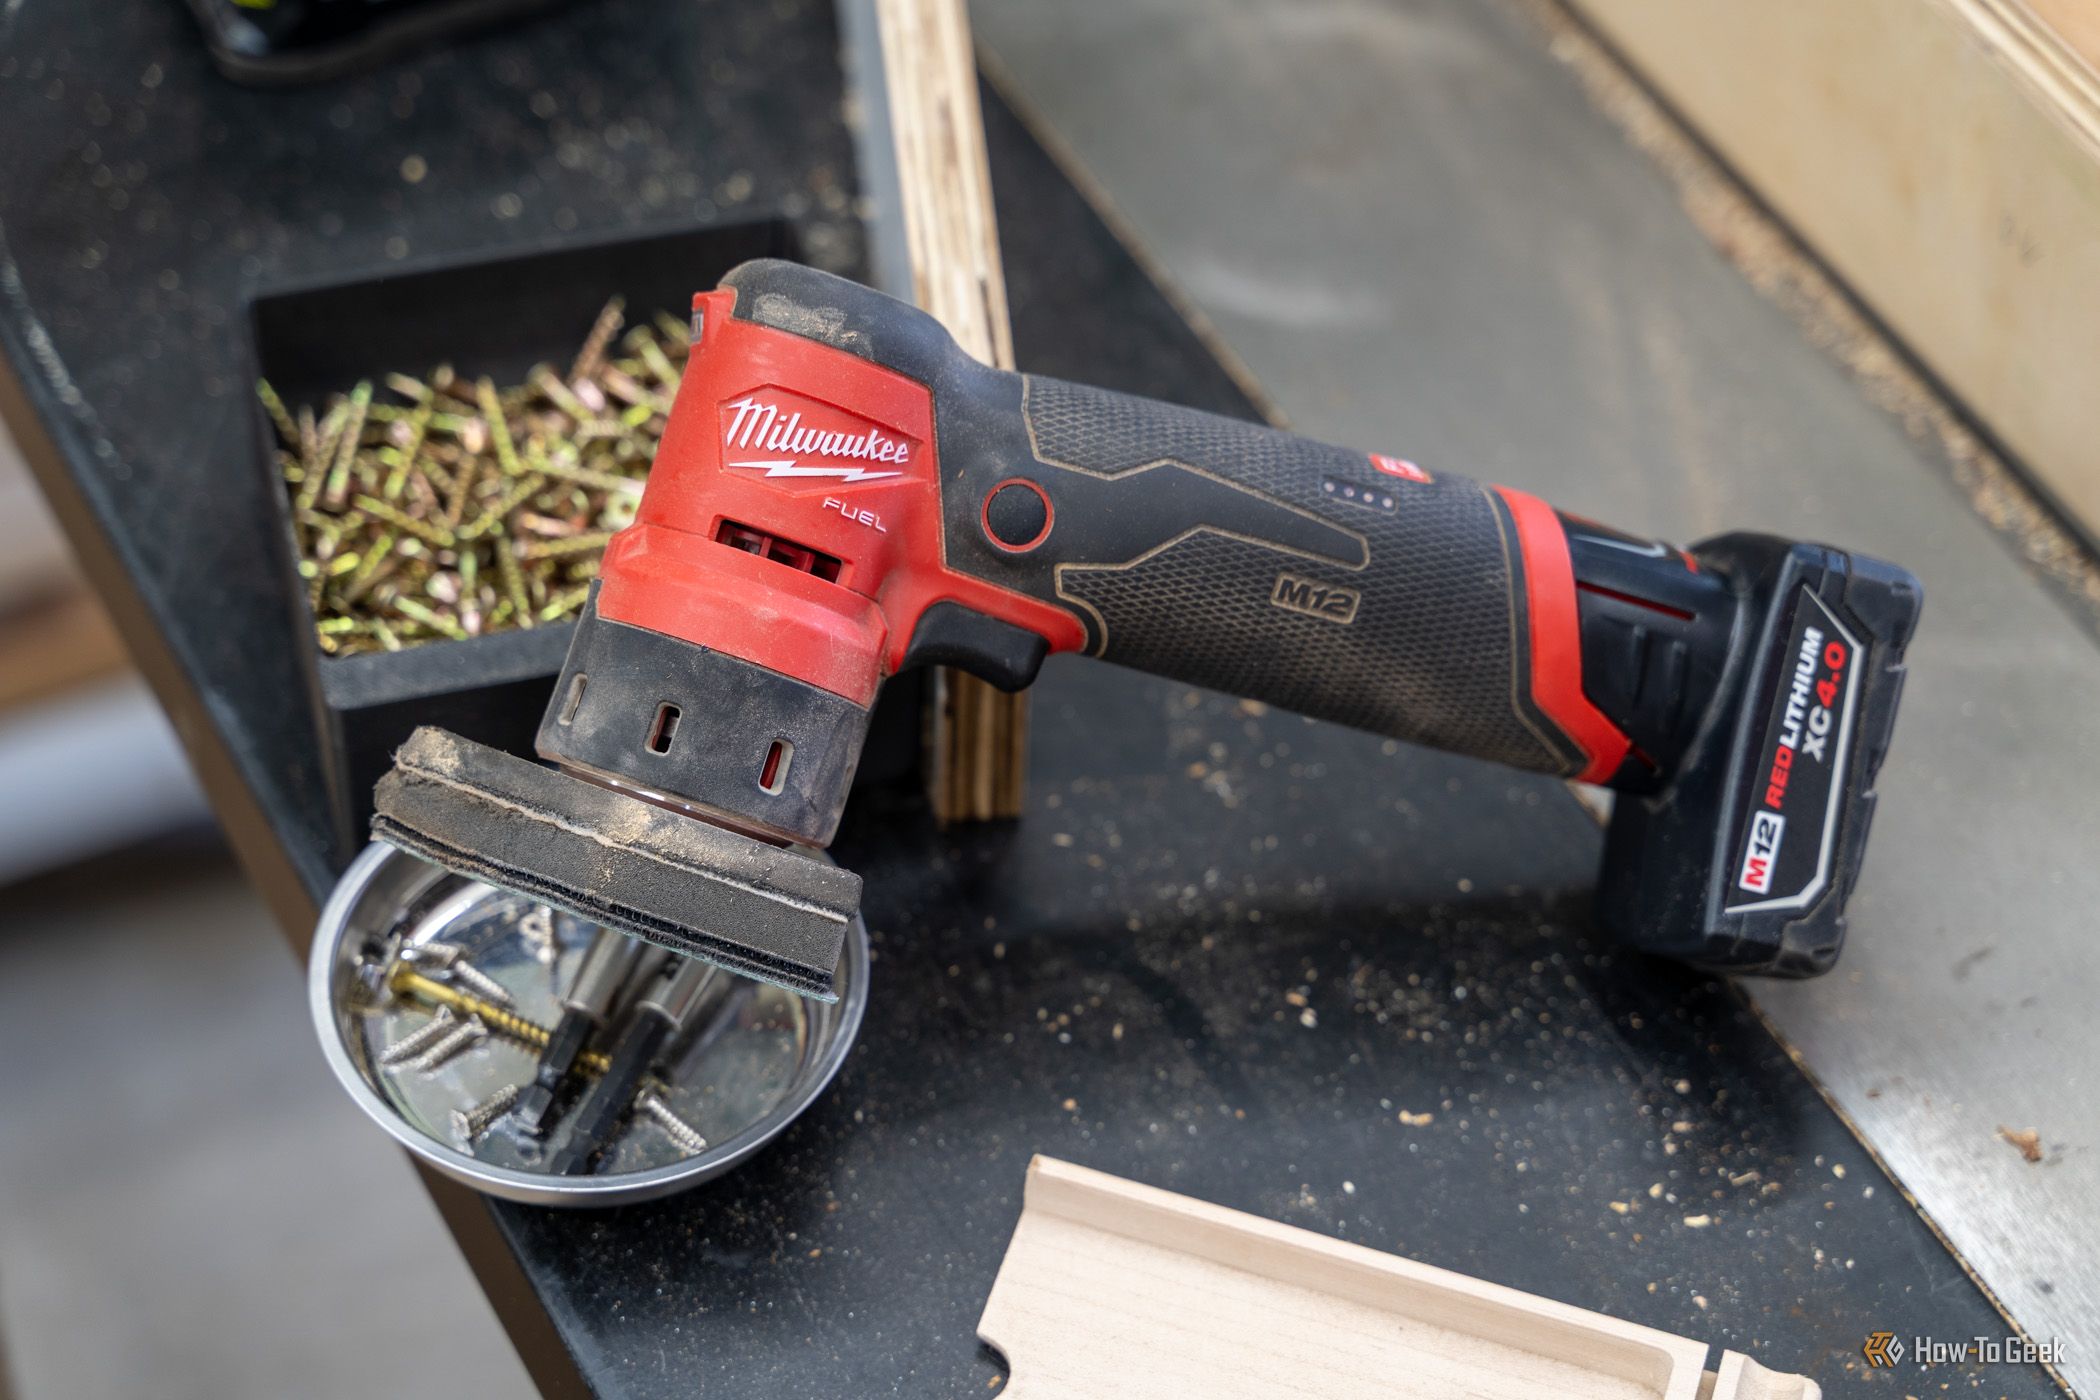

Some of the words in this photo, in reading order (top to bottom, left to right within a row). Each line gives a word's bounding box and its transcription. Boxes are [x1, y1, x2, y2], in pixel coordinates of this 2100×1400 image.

[727, 397, 909, 464] Milwaukee
[822, 497, 887, 533] FUEL
[1276, 579, 1354, 617] M12
[1743, 817, 1778, 887] M12
